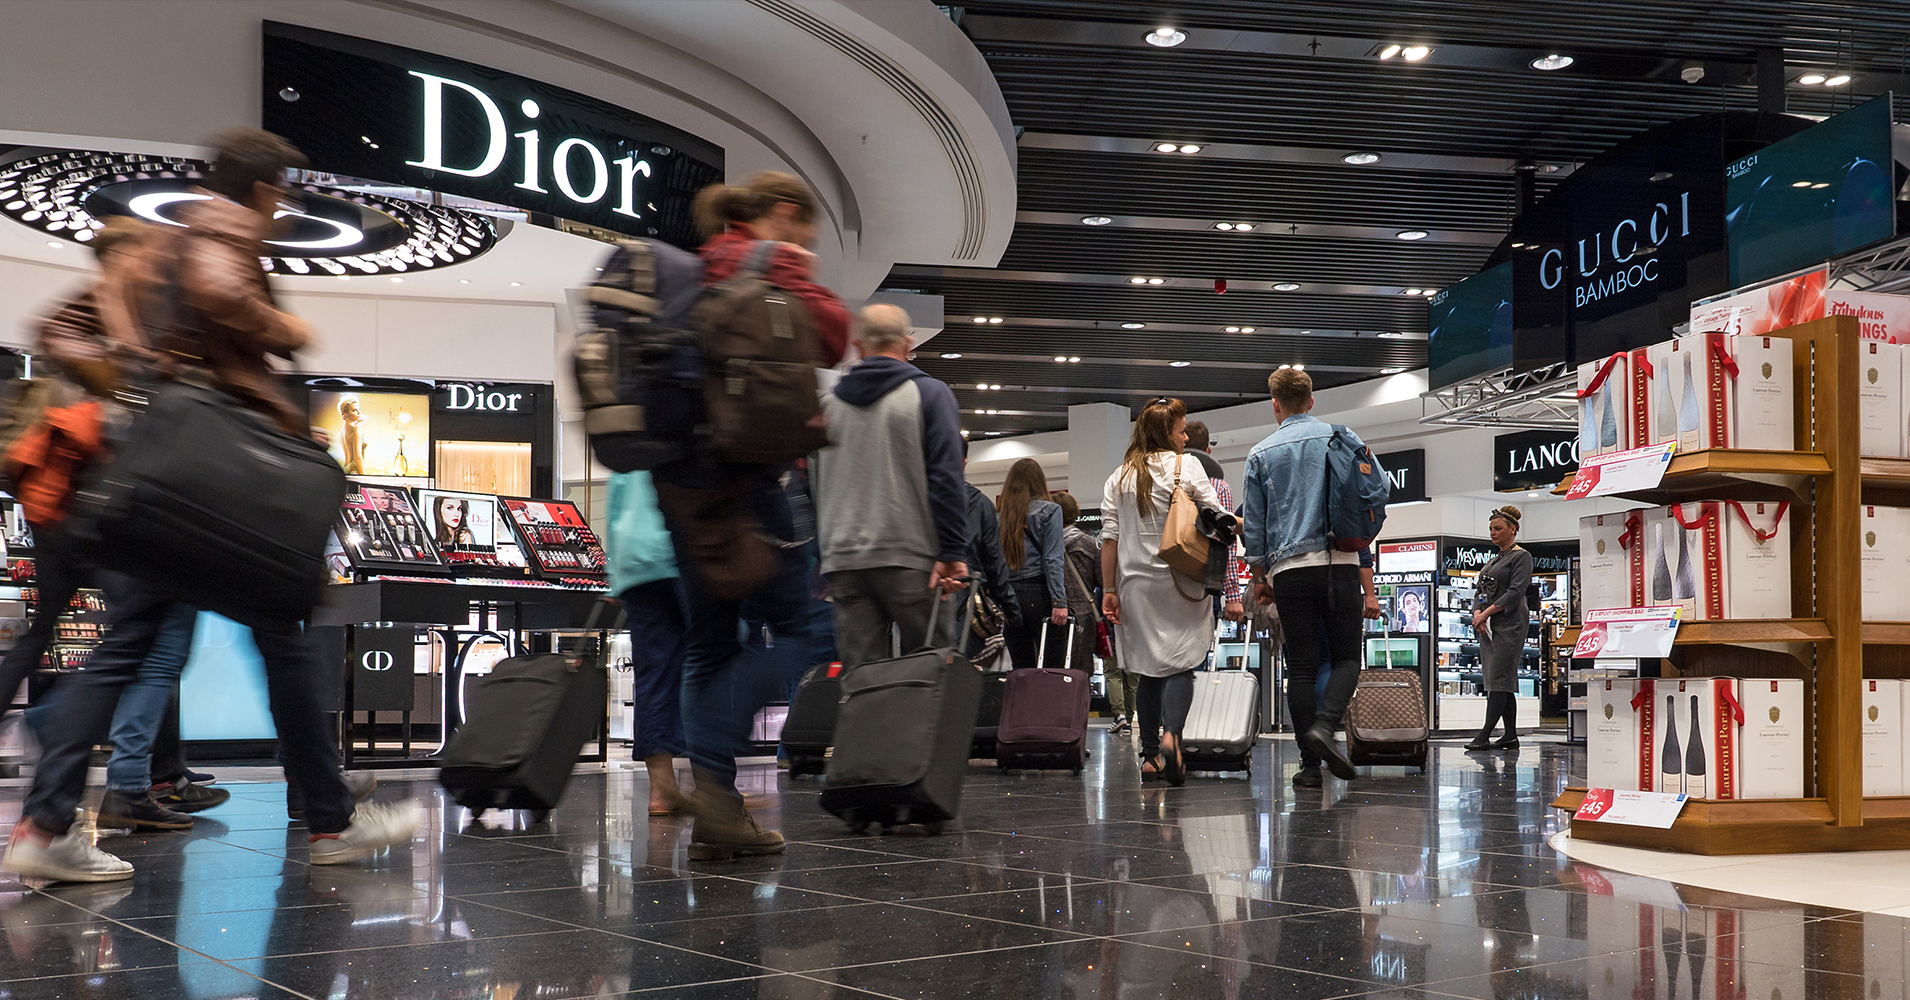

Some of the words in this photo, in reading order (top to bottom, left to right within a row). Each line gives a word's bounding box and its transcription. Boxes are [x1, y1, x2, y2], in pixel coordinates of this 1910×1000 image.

[405, 70, 651, 219] Dior
[1540, 191, 1690, 290] GUCCI
[1828, 300, 1884, 320] Fabulous
[1858, 322, 1888, 340] INGS
[446, 383, 522, 411] Dior
[1386, 468, 1409, 489] NT
[1568, 480, 1592, 494] £45
[471, 514, 489, 524] Dior
[1398, 543, 1434, 552] CLARINS
[1706, 516, 1720, 618] Laurent-Perrier
[1372, 575, 1403, 584] GIORGIO
[1577, 636, 1600, 652] £45
[1719, 698, 1730, 797] Laurent-Perrie
[1586, 793, 1600, 801] Only
[1579, 801, 1604, 815] £45
